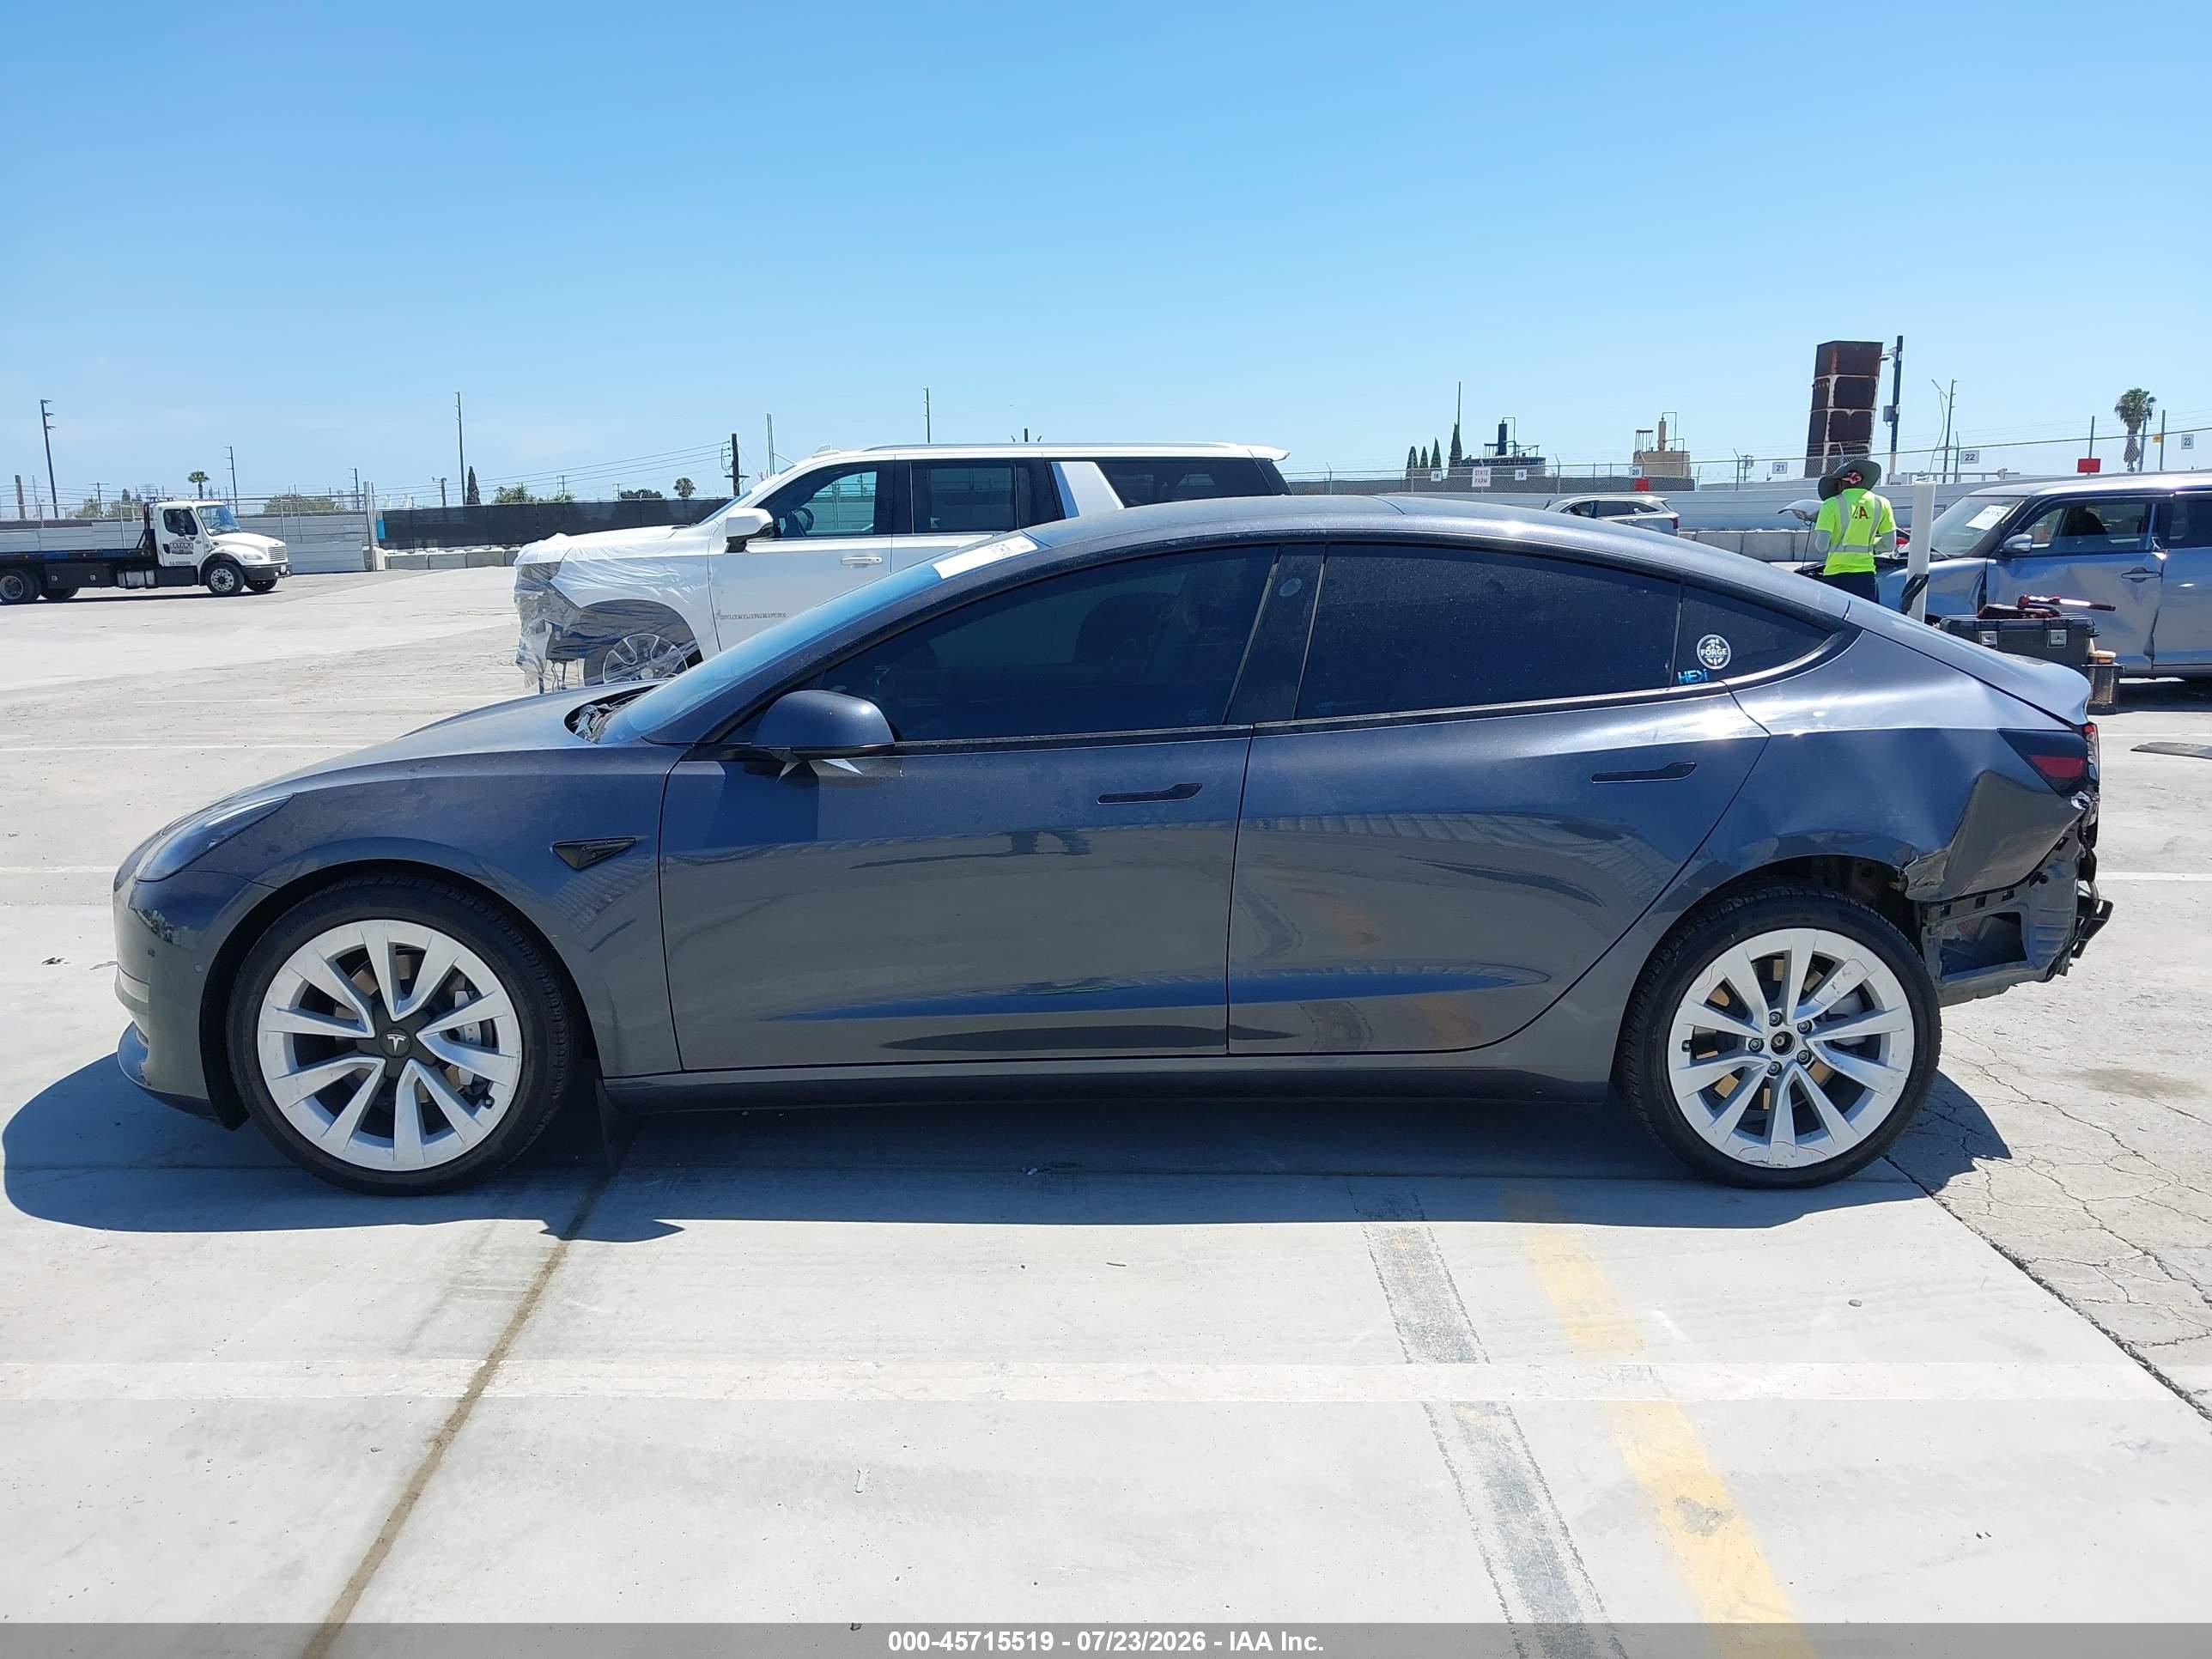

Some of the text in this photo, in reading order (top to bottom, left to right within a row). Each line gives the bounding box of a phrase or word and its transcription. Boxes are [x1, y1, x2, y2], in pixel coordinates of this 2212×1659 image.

[2184, 437, 2191, 447] 23
[1964, 453, 1976, 461] 22
[1700, 647, 1728, 657] FORGE
